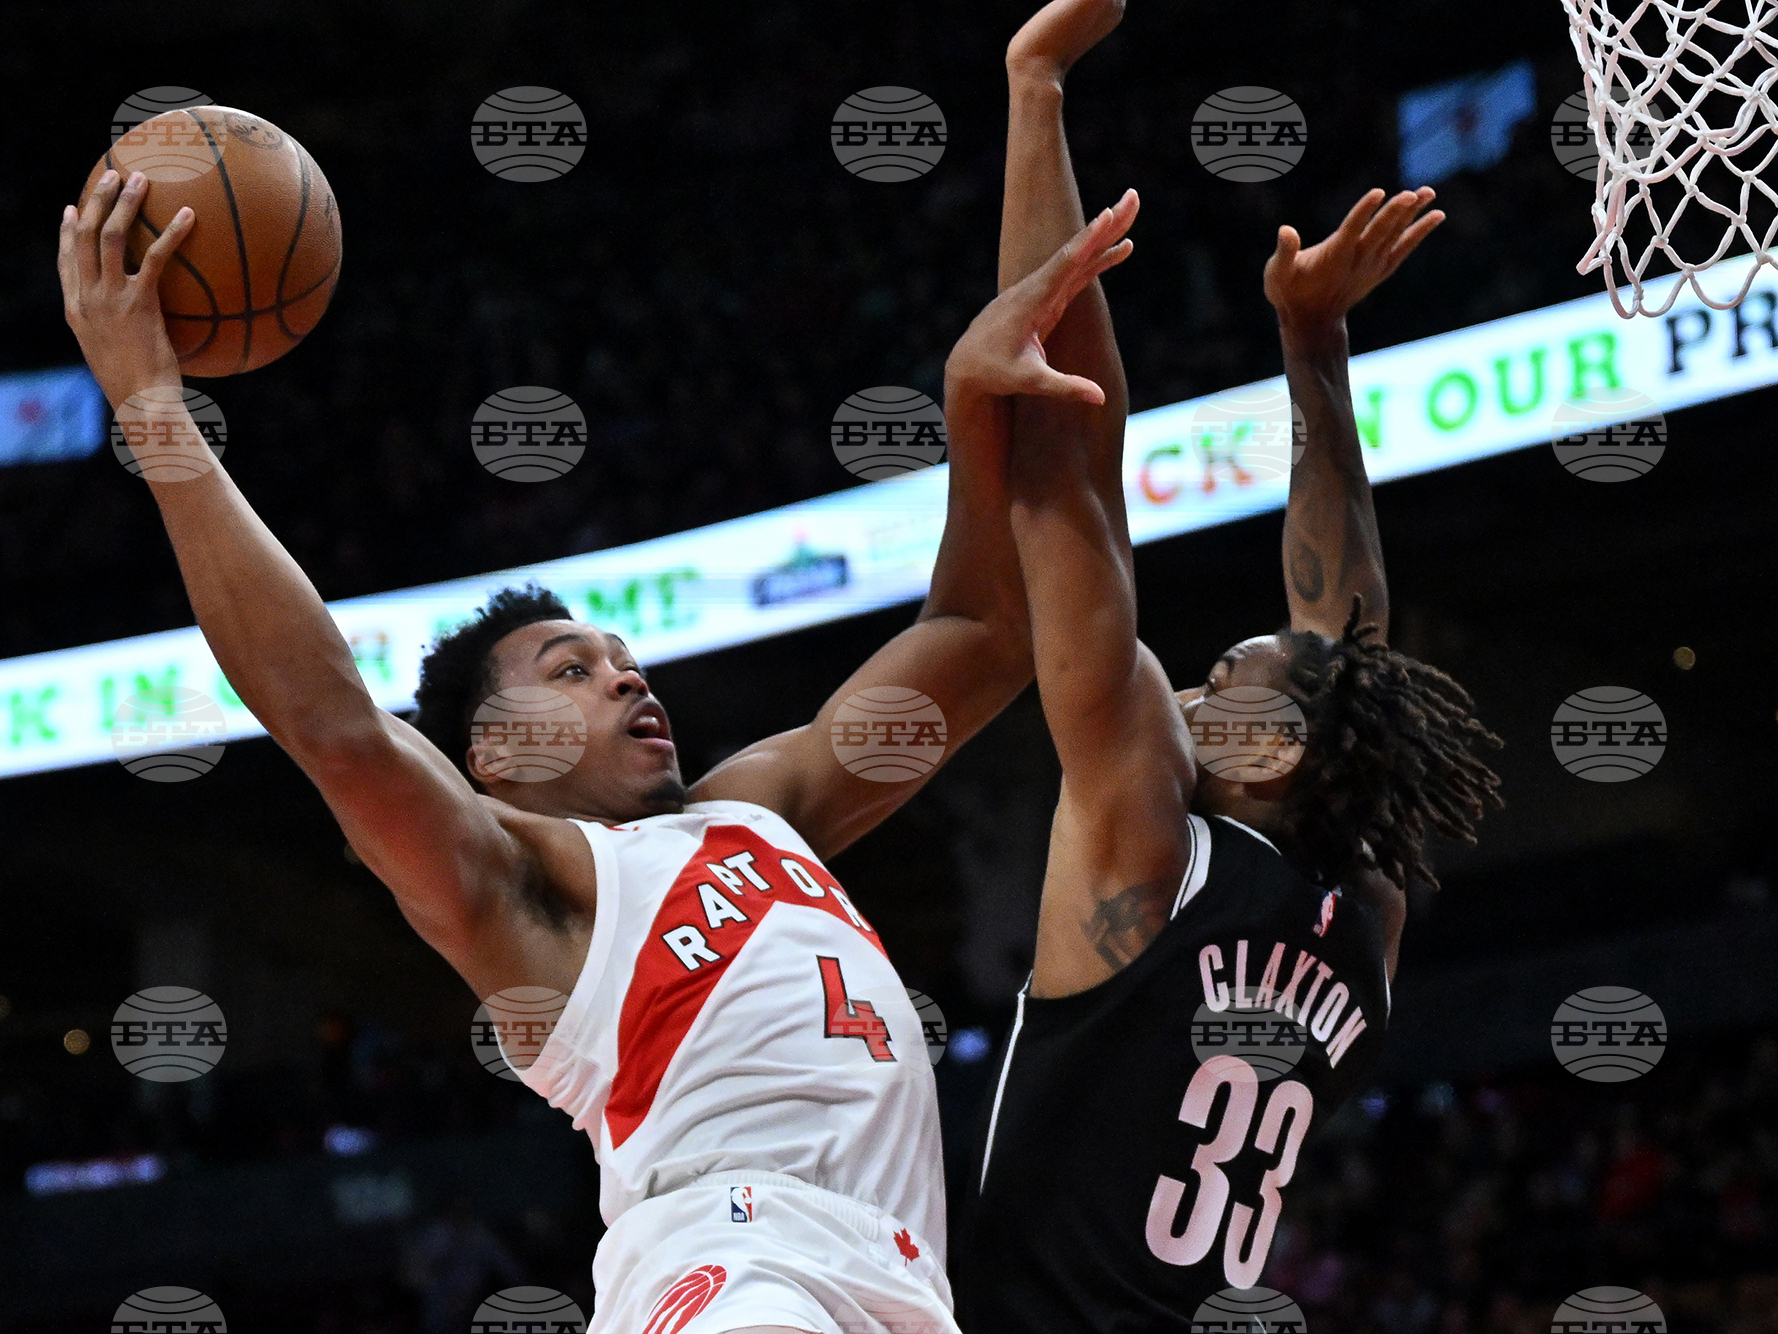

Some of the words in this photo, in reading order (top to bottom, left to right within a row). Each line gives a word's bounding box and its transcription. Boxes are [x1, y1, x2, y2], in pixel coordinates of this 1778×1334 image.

[1139, 422, 1253, 505] CK
[1427, 332, 1622, 432] OUR
[662, 850, 874, 972] RAPTOR
[815, 954, 898, 1063] 4
[1197, 938, 1369, 1069] CLAXTON
[1144, 1053, 1314, 1291] 33
